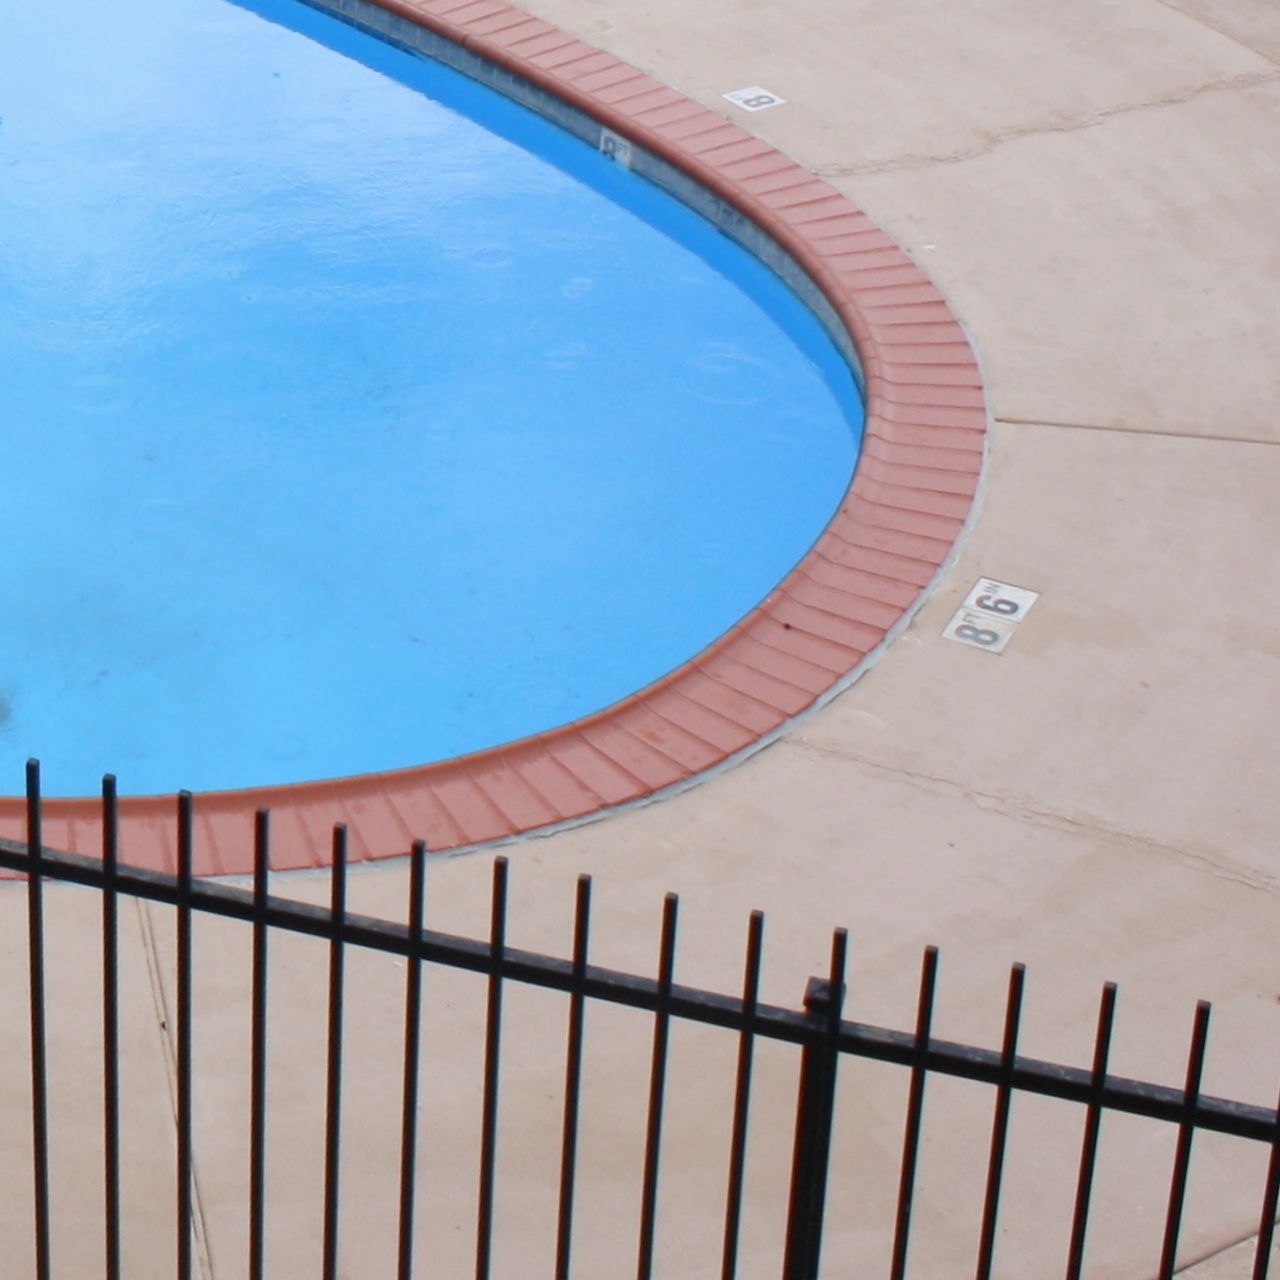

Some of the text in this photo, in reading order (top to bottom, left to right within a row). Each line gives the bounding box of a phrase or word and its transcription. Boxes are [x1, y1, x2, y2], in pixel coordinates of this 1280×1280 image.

[742, 95, 776, 108] 8
[975, 594, 1019, 615] 6
[954, 624, 999, 646] 8
